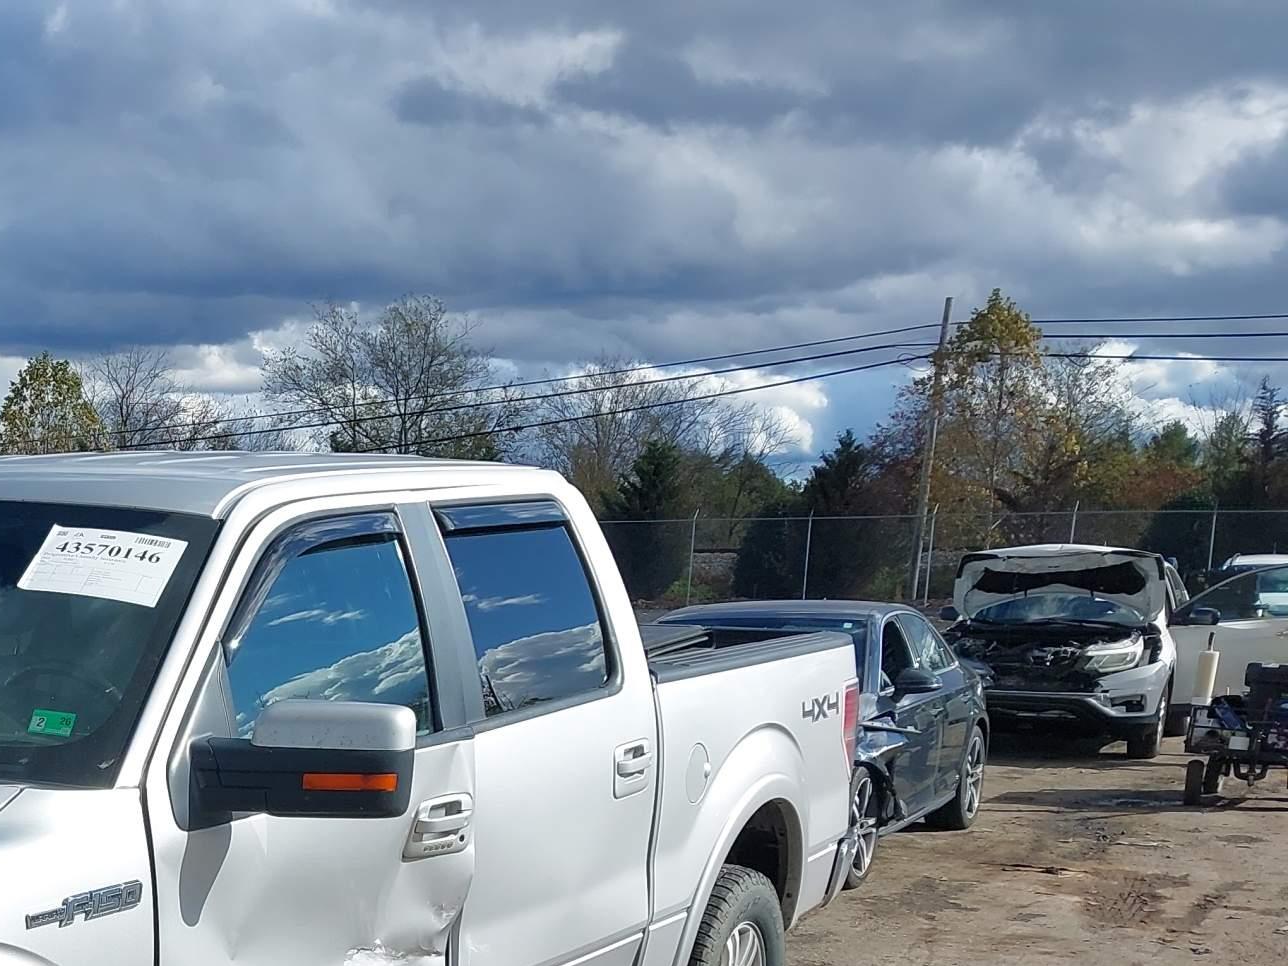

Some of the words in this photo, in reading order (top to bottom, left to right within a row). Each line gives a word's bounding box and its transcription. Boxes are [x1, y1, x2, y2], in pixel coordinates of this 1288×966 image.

[55, 541, 165, 565] 43570146
[36, 717, 45, 728] 2
[60, 716, 72, 727] 26
